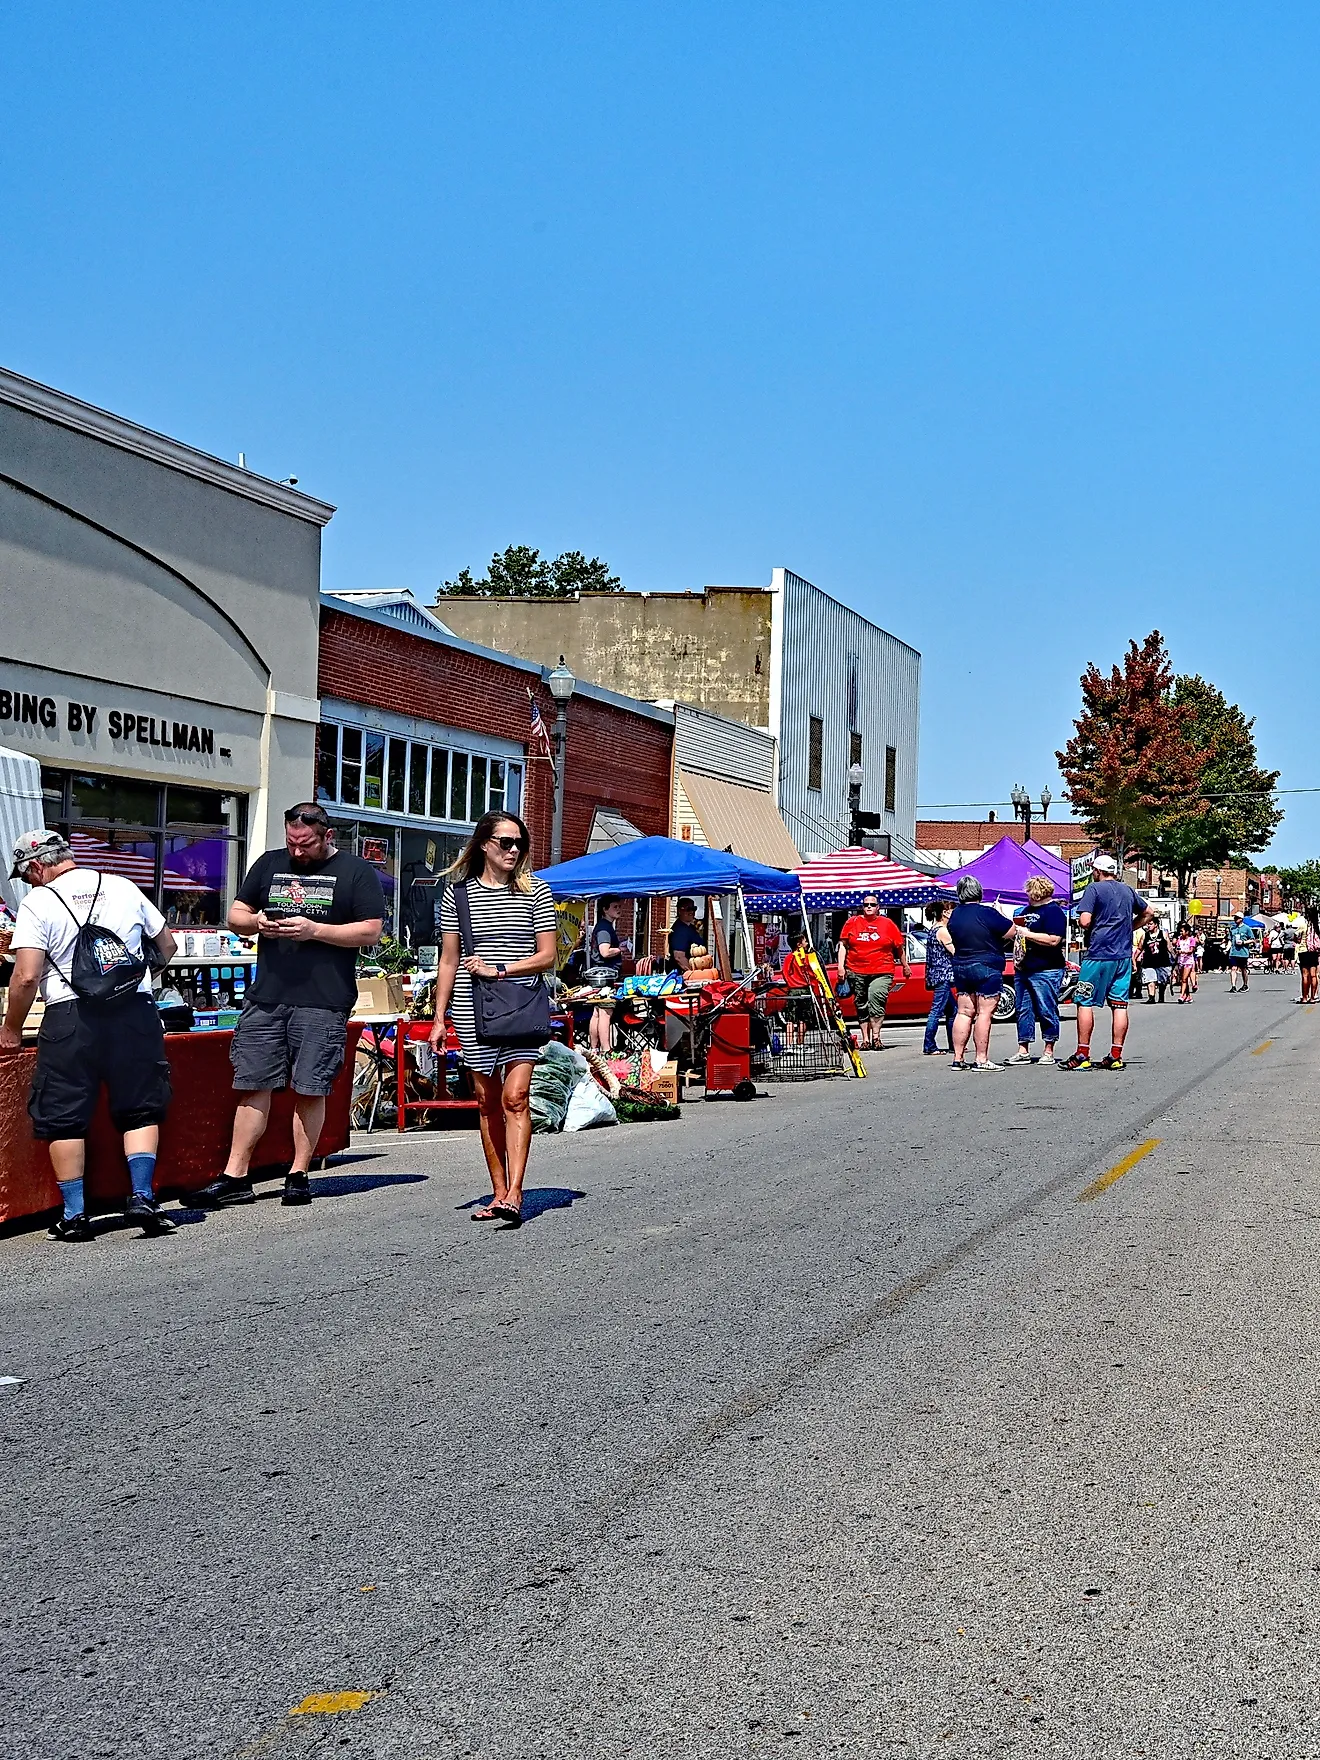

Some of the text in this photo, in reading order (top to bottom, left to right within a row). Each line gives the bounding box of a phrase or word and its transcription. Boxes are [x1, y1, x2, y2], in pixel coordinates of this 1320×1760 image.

[67, 702, 97, 734] BY
[108, 710, 214, 754] SPELLMAN
[277, 901, 323, 909] TOUCHDOWN
